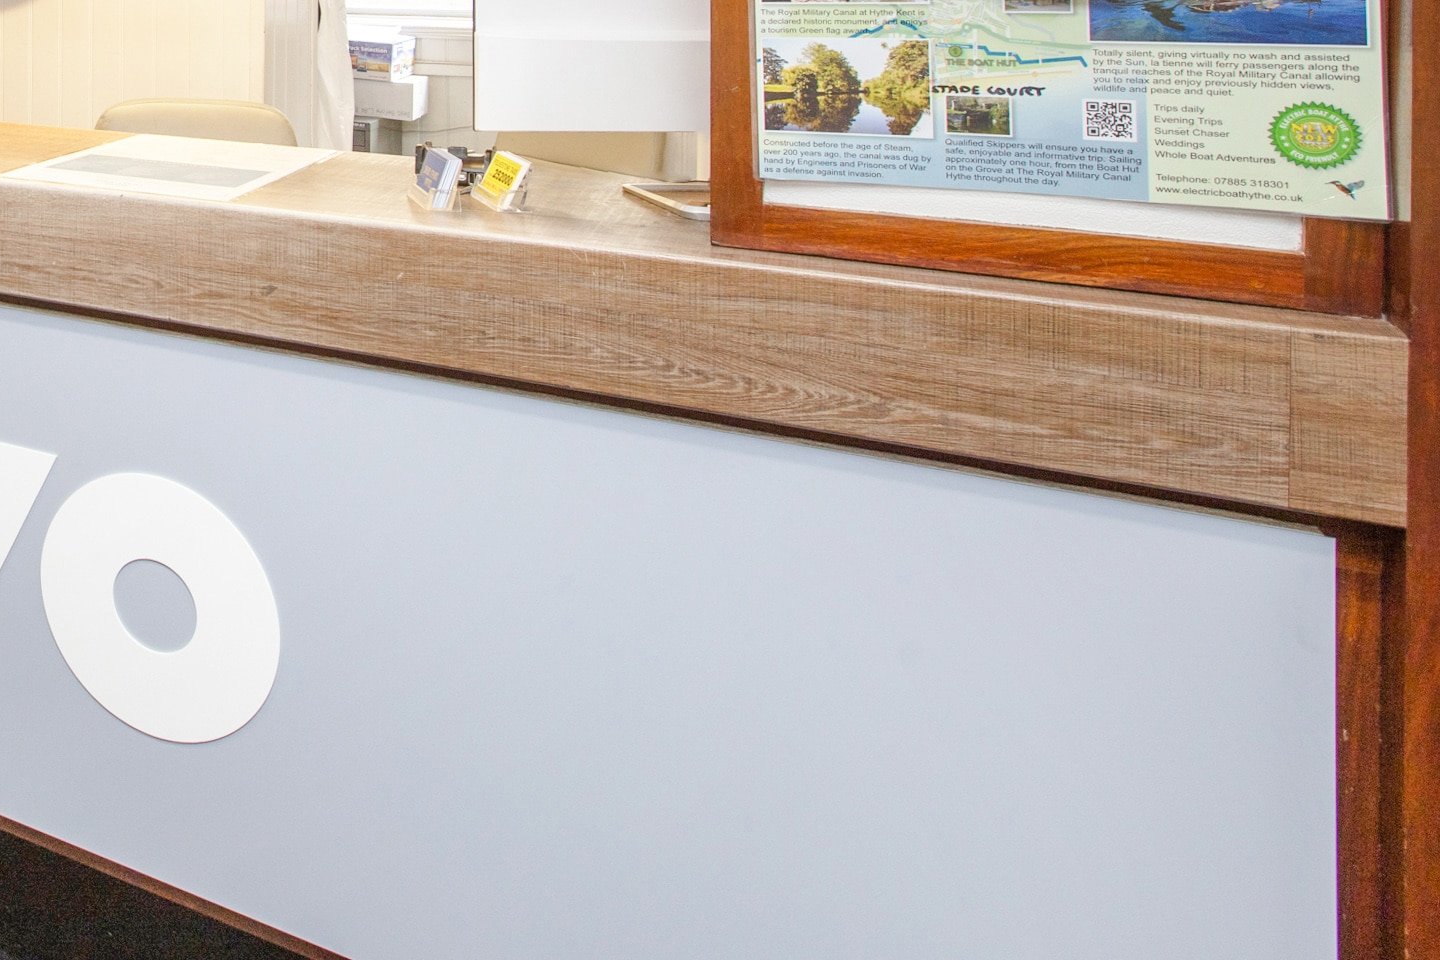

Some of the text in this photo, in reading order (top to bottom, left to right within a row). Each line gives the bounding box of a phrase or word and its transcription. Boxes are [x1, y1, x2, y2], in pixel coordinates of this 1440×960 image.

[760, 8, 775, 16] The
[777, 8, 800, 17] Royal
[801, 8, 831, 17] Military
[832, 8, 857, 16] Canal
[868, 9, 894, 17] Hythe
[798, 26, 823, 34] Green
[825, 26, 841, 35] flag
[361, 46, 388, 54] Selection
[1092, 48, 1123, 59] Totally
[1157, 49, 1189, 60] giving
[1189, 50, 1230, 61] virtually
[1230, 52, 1246, 60] no
[1248, 51, 1277, 60] wash
[1280, 52, 1301, 61] and
[1303, 52, 1350, 62] assisted
[968, 59, 994, 67] BOAT
[996, 59, 1017, 67] HUT
[932, 85, 1046, 96] STADE COURT
[1154, 104, 1205, 115] Trips daily
[1308, 109, 1328, 117] BOAT
[1154, 115, 1223, 127] Evening Trips
[1154, 127, 1229, 138] Sunset Chaser
[1154, 138, 1205, 151] Weddings
[1155, 151, 1276, 164] Whole Boat Adventures
[1156, 174, 1289, 188] Telephone: 07885 318301
[1156, 185, 1304, 202] www.electricboathythe.co.uk
